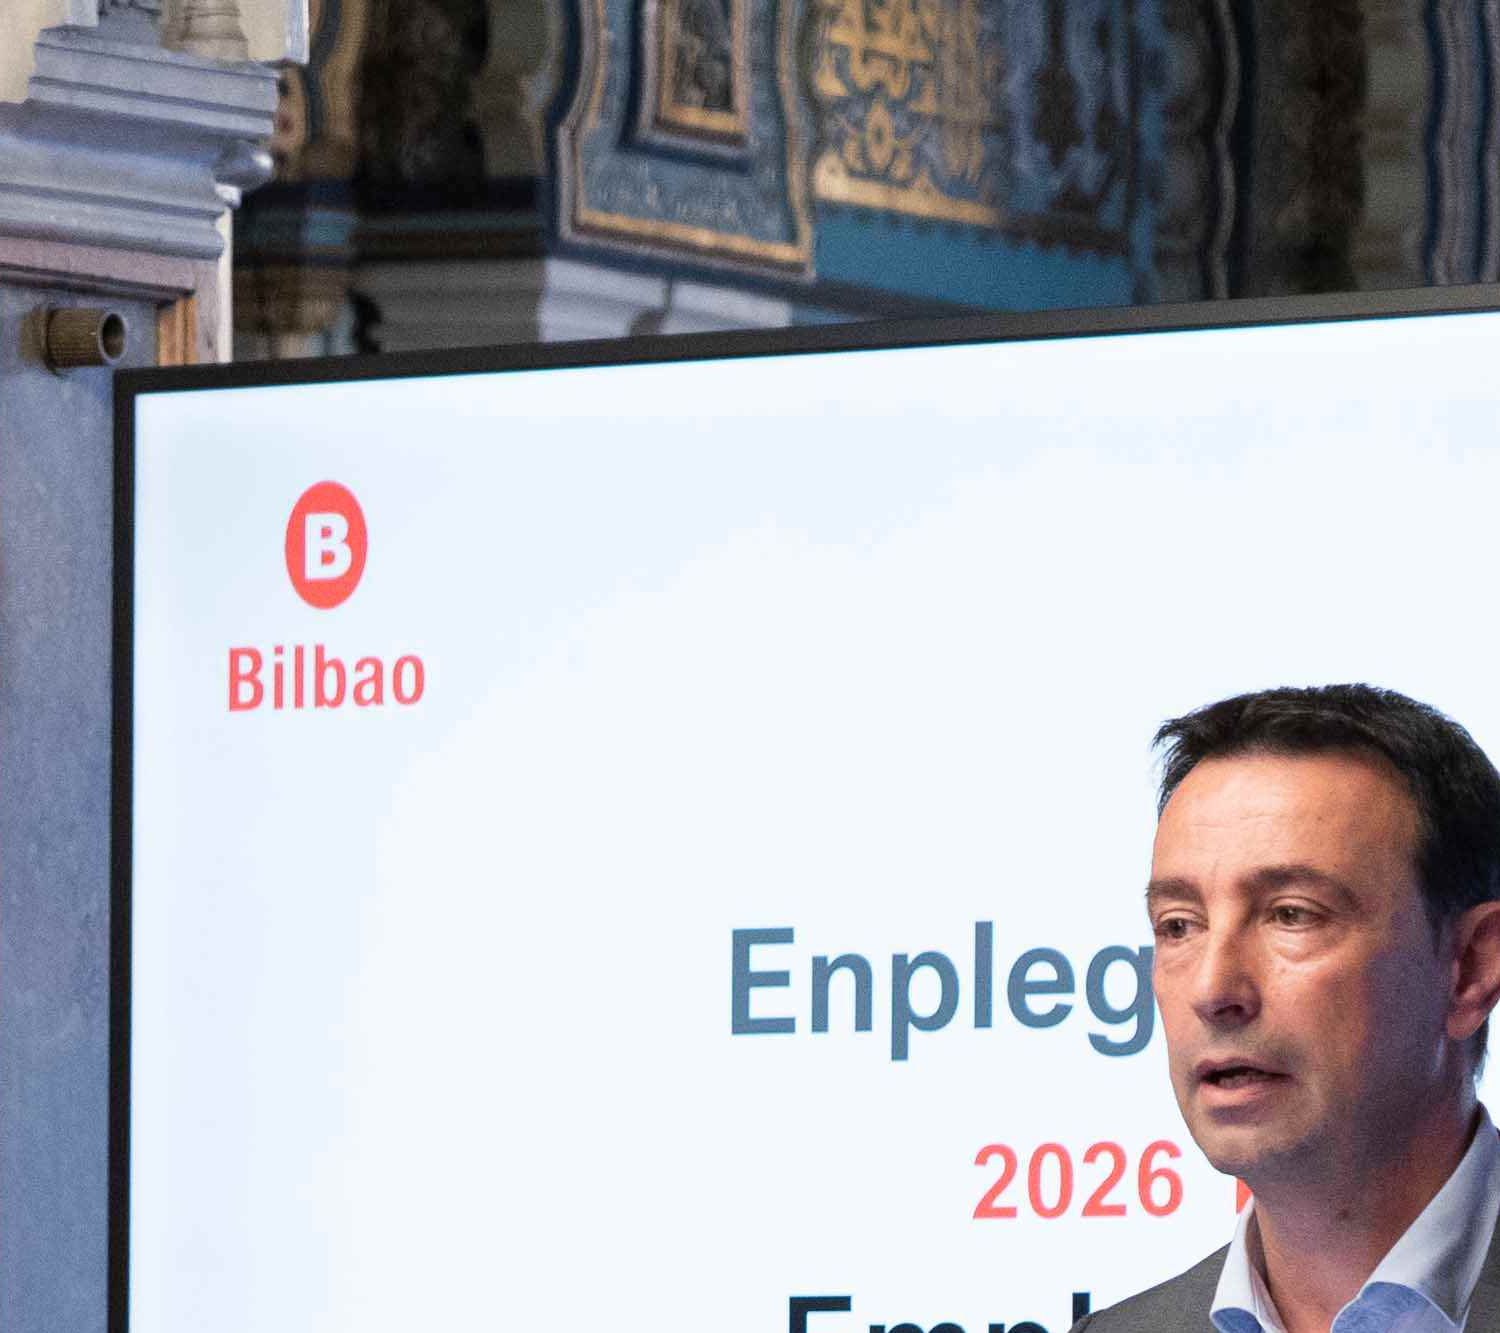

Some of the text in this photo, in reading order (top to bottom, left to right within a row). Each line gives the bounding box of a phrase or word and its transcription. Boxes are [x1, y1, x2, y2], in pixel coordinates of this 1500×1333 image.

[304, 511, 352, 582] B
[228, 644, 426, 713] Bilbao
[729, 920, 1156, 1062] Enpleg
[973, 1139, 1184, 1220] 2026
